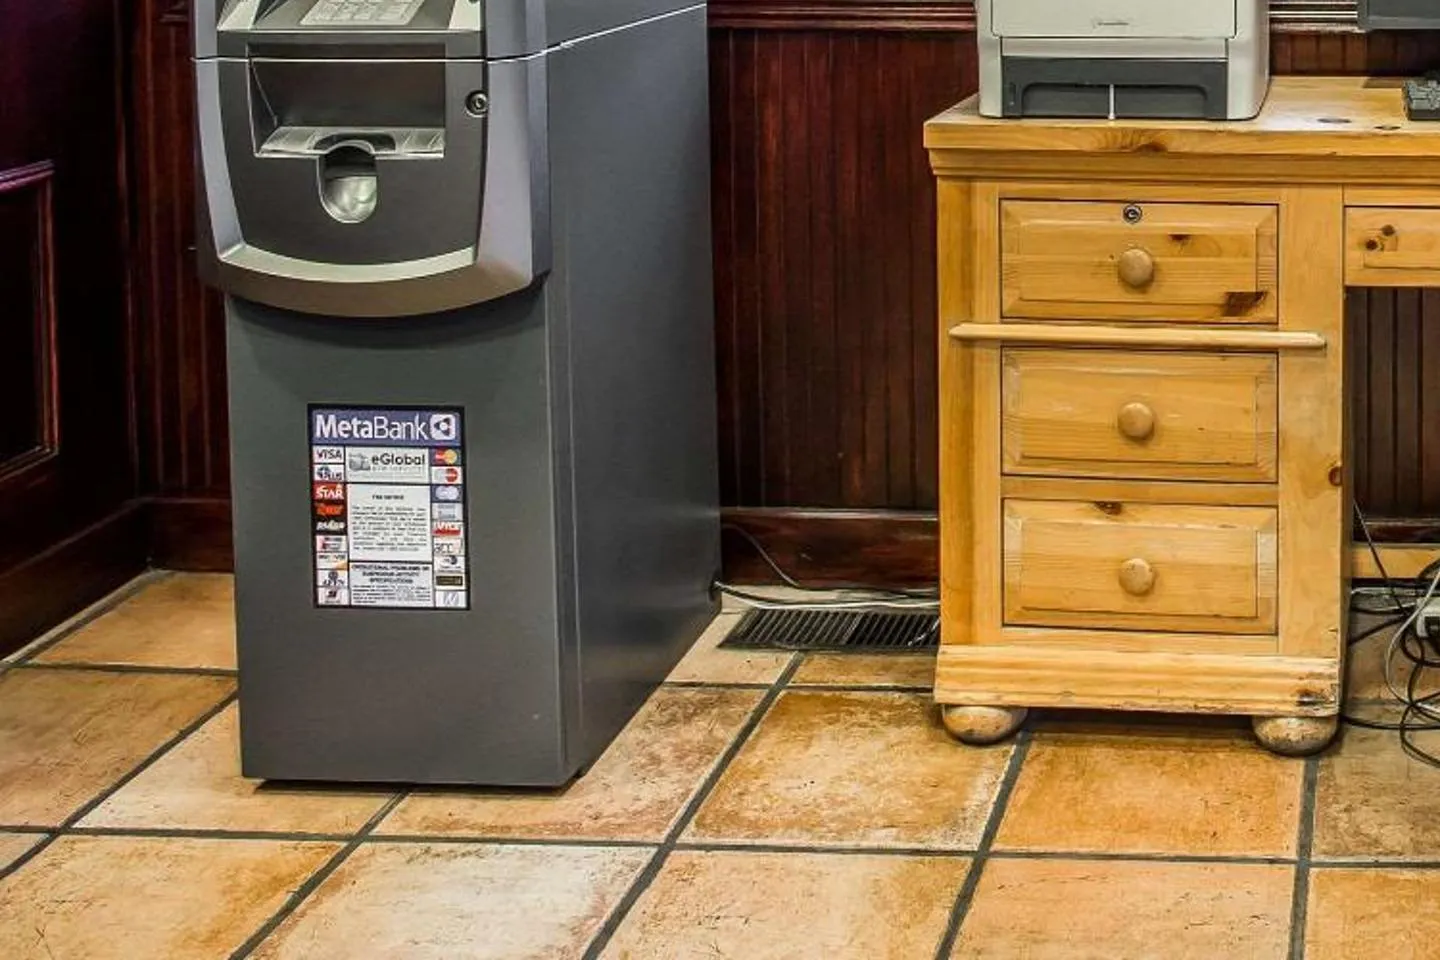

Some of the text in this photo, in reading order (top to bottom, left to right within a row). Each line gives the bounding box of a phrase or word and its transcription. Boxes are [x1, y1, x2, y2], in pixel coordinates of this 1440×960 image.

[316, 414, 429, 440] MetaBank
[316, 450, 343, 460] VISA
[371, 453, 426, 466] eGlobal
[316, 486, 344, 500] STAR
